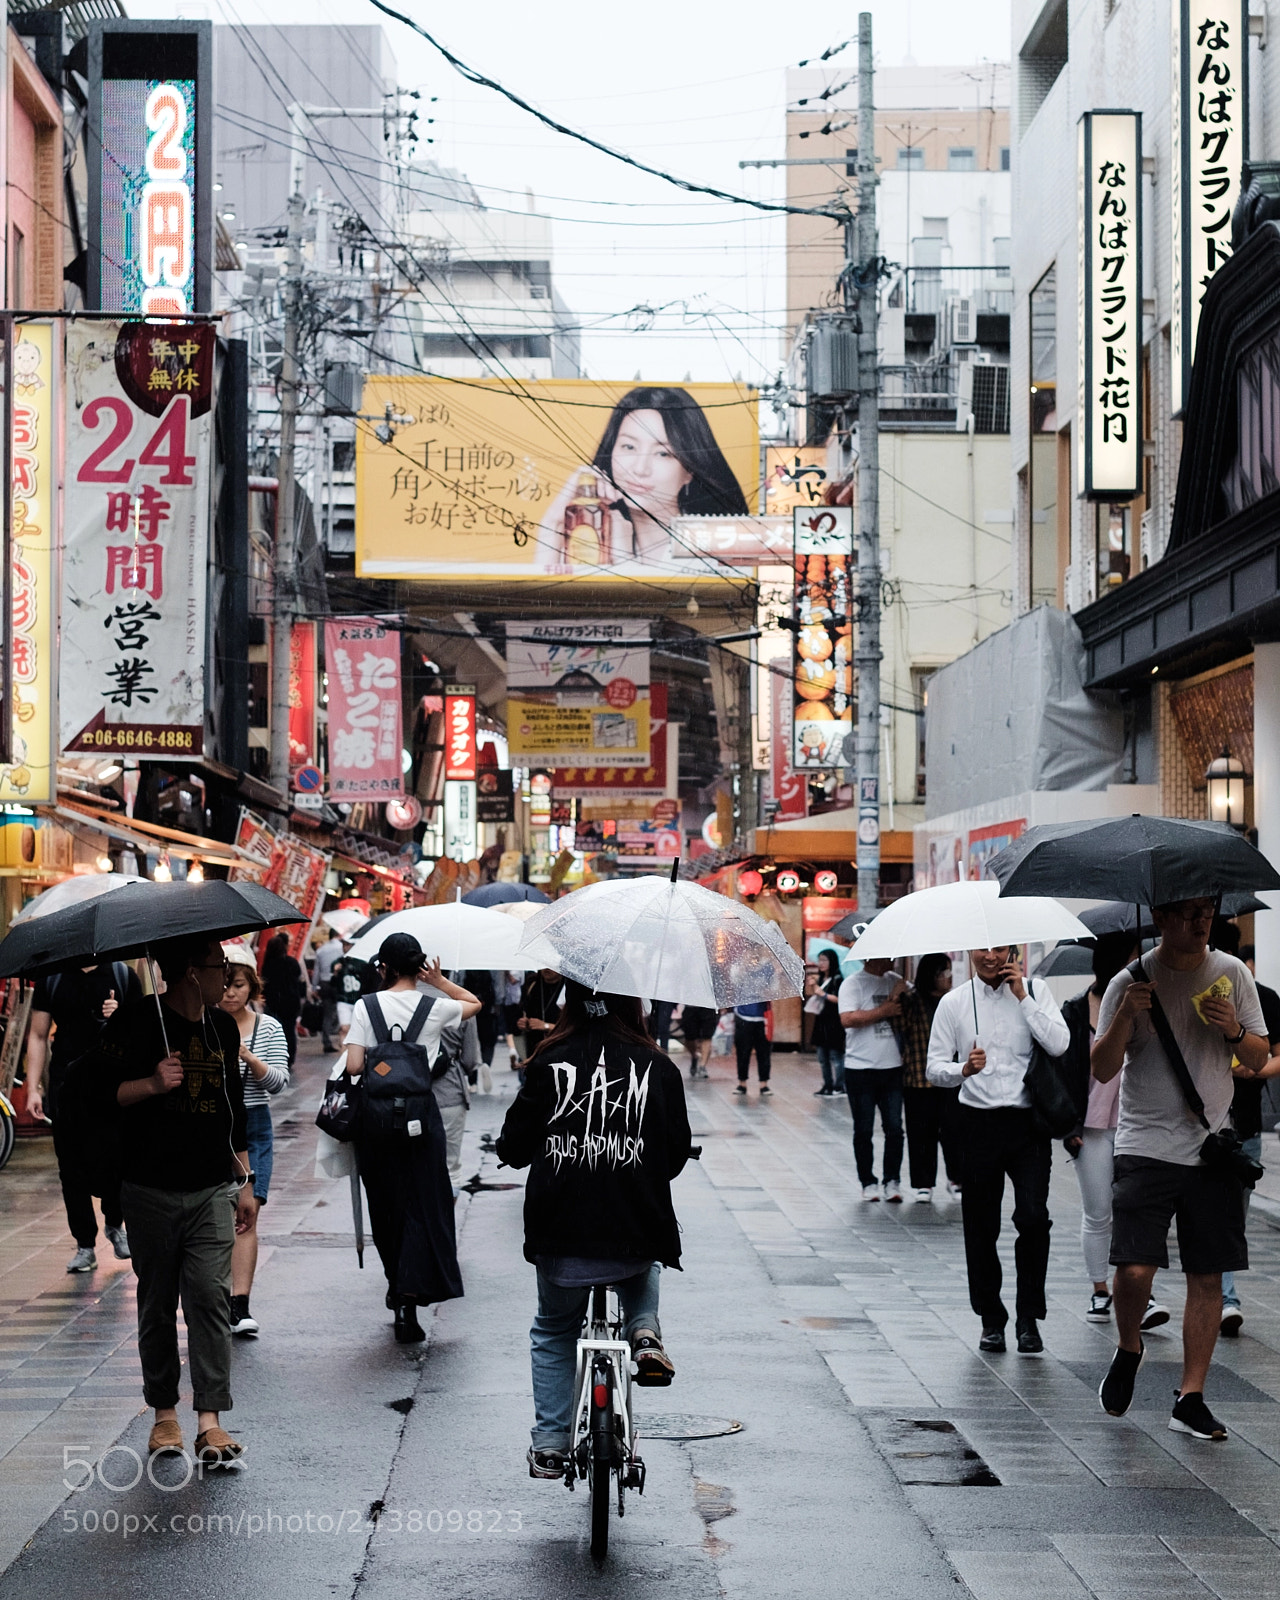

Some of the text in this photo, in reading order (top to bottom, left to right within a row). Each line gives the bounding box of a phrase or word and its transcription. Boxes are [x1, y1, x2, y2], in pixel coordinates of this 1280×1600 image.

[143, 84, 192, 324] 2円
[1098, 160, 1131, 444] なんばグランド花月
[77, 397, 196, 485] 24
[411, 439, 514, 472] 千日前の
[391, 467, 551, 501] 角ハイボールが
[185, 598, 196, 656] HASSEN
[94, 729, 193, 750] 06-6646-4888
[451, 699, 471, 766] カラオケ
